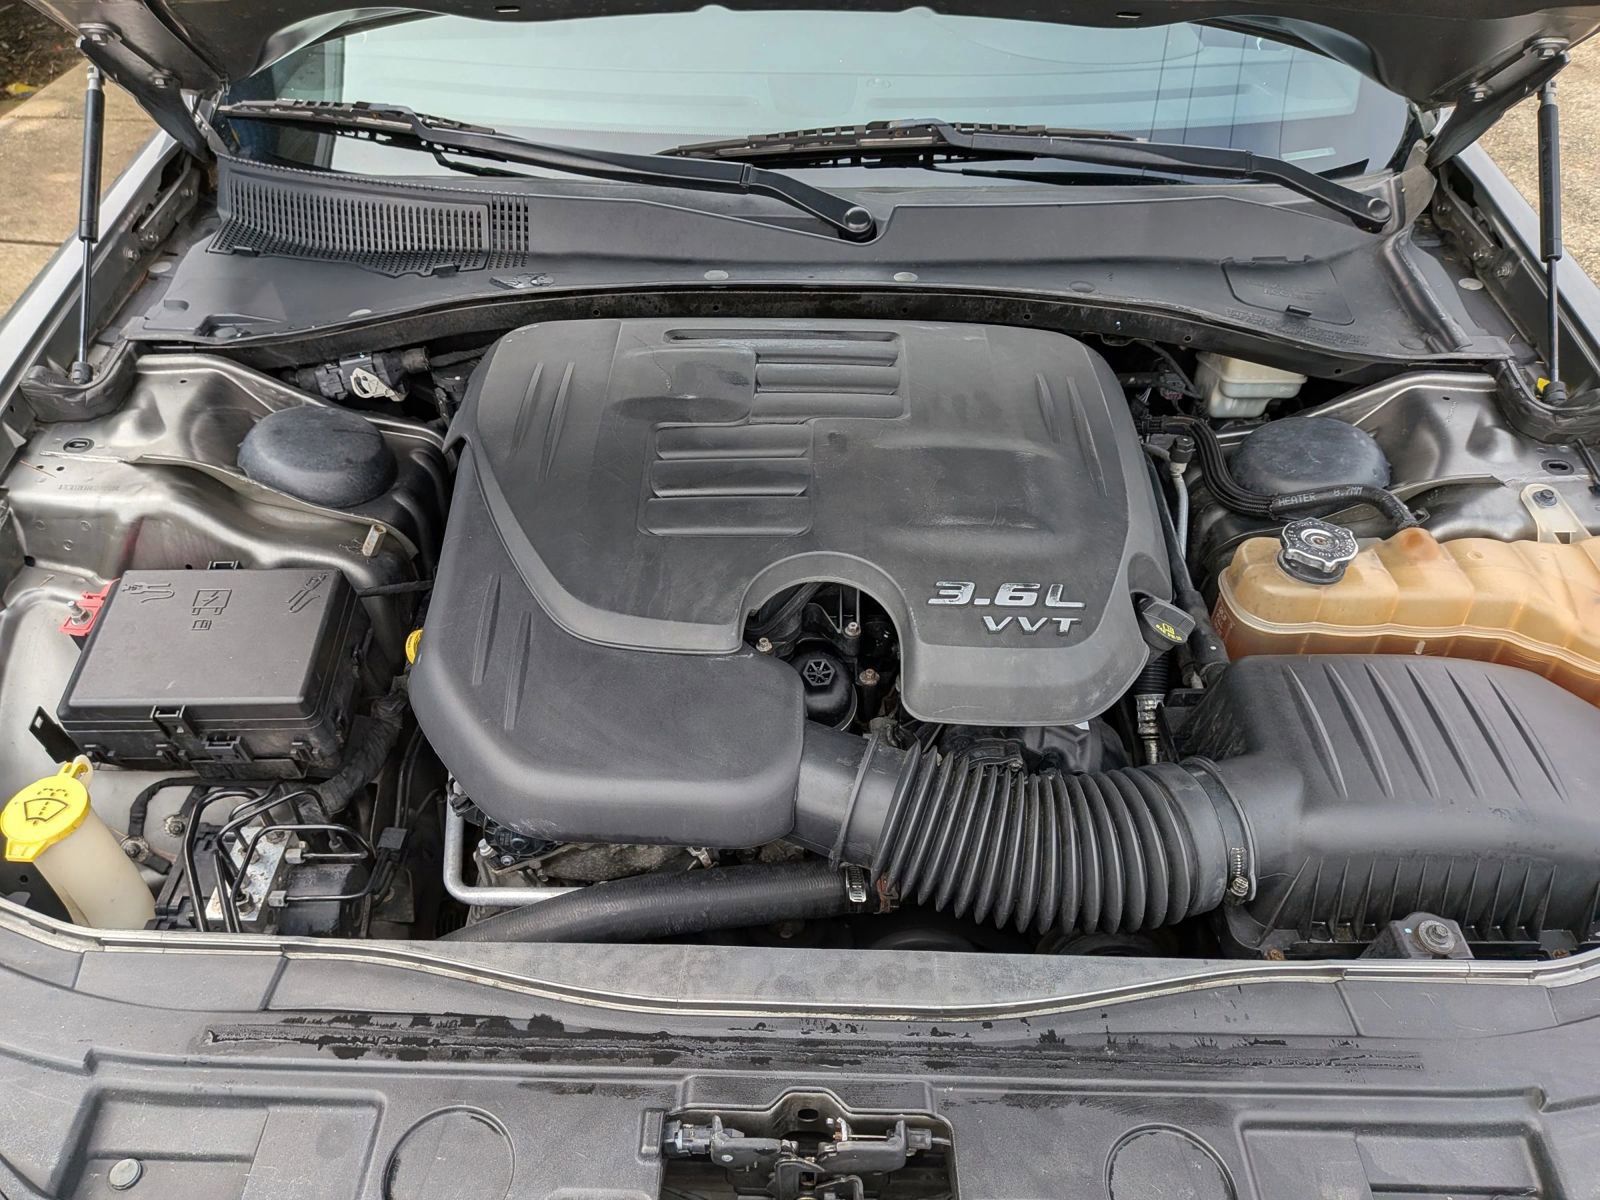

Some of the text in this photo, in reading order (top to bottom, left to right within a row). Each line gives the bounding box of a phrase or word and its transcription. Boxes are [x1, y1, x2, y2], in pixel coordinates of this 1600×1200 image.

[1278, 492, 1317, 506] HEATER
[928, 581, 1086, 608] 3.6L
[982, 615, 1082, 635] VVT
